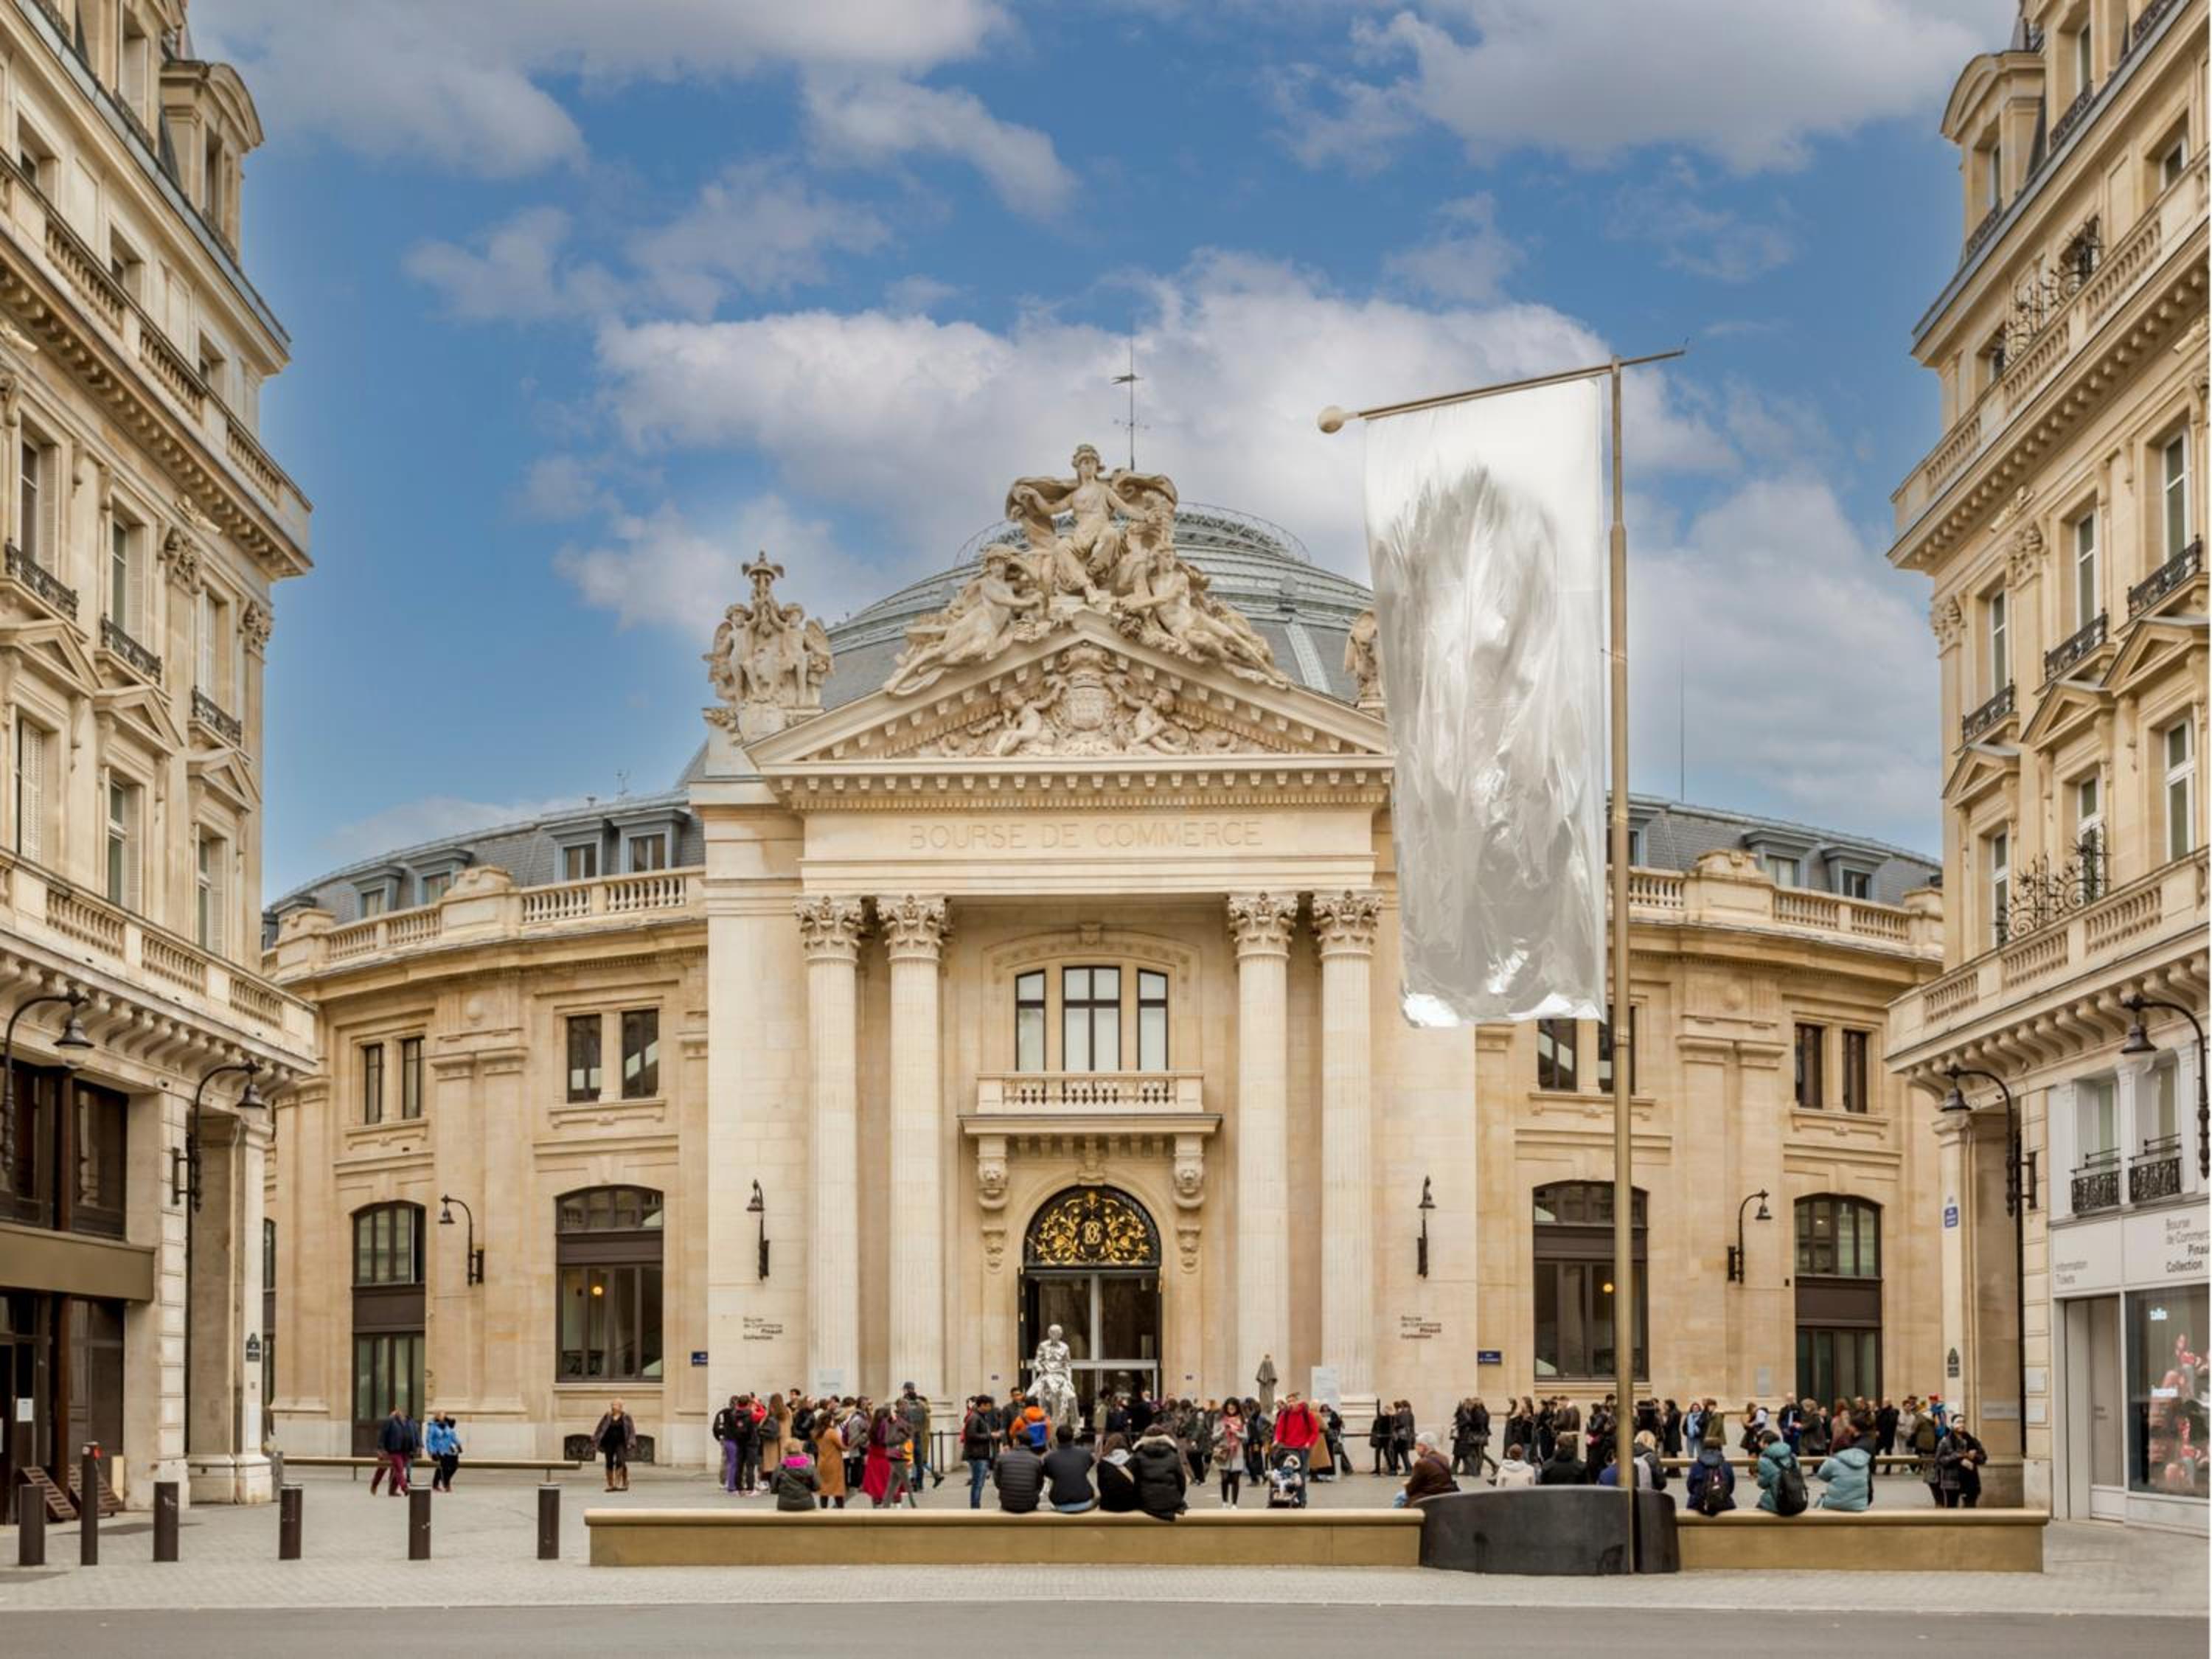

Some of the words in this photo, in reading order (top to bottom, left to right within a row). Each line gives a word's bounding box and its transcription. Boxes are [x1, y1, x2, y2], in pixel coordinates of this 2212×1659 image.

[909, 824, 1027, 850] BOURSE
[1041, 823, 1081, 849] DE
[1093, 821, 1264, 849] COMMERCE
[2166, 1218, 2191, 1231] Bourse
[2166, 1259, 2202, 1273] Collection
